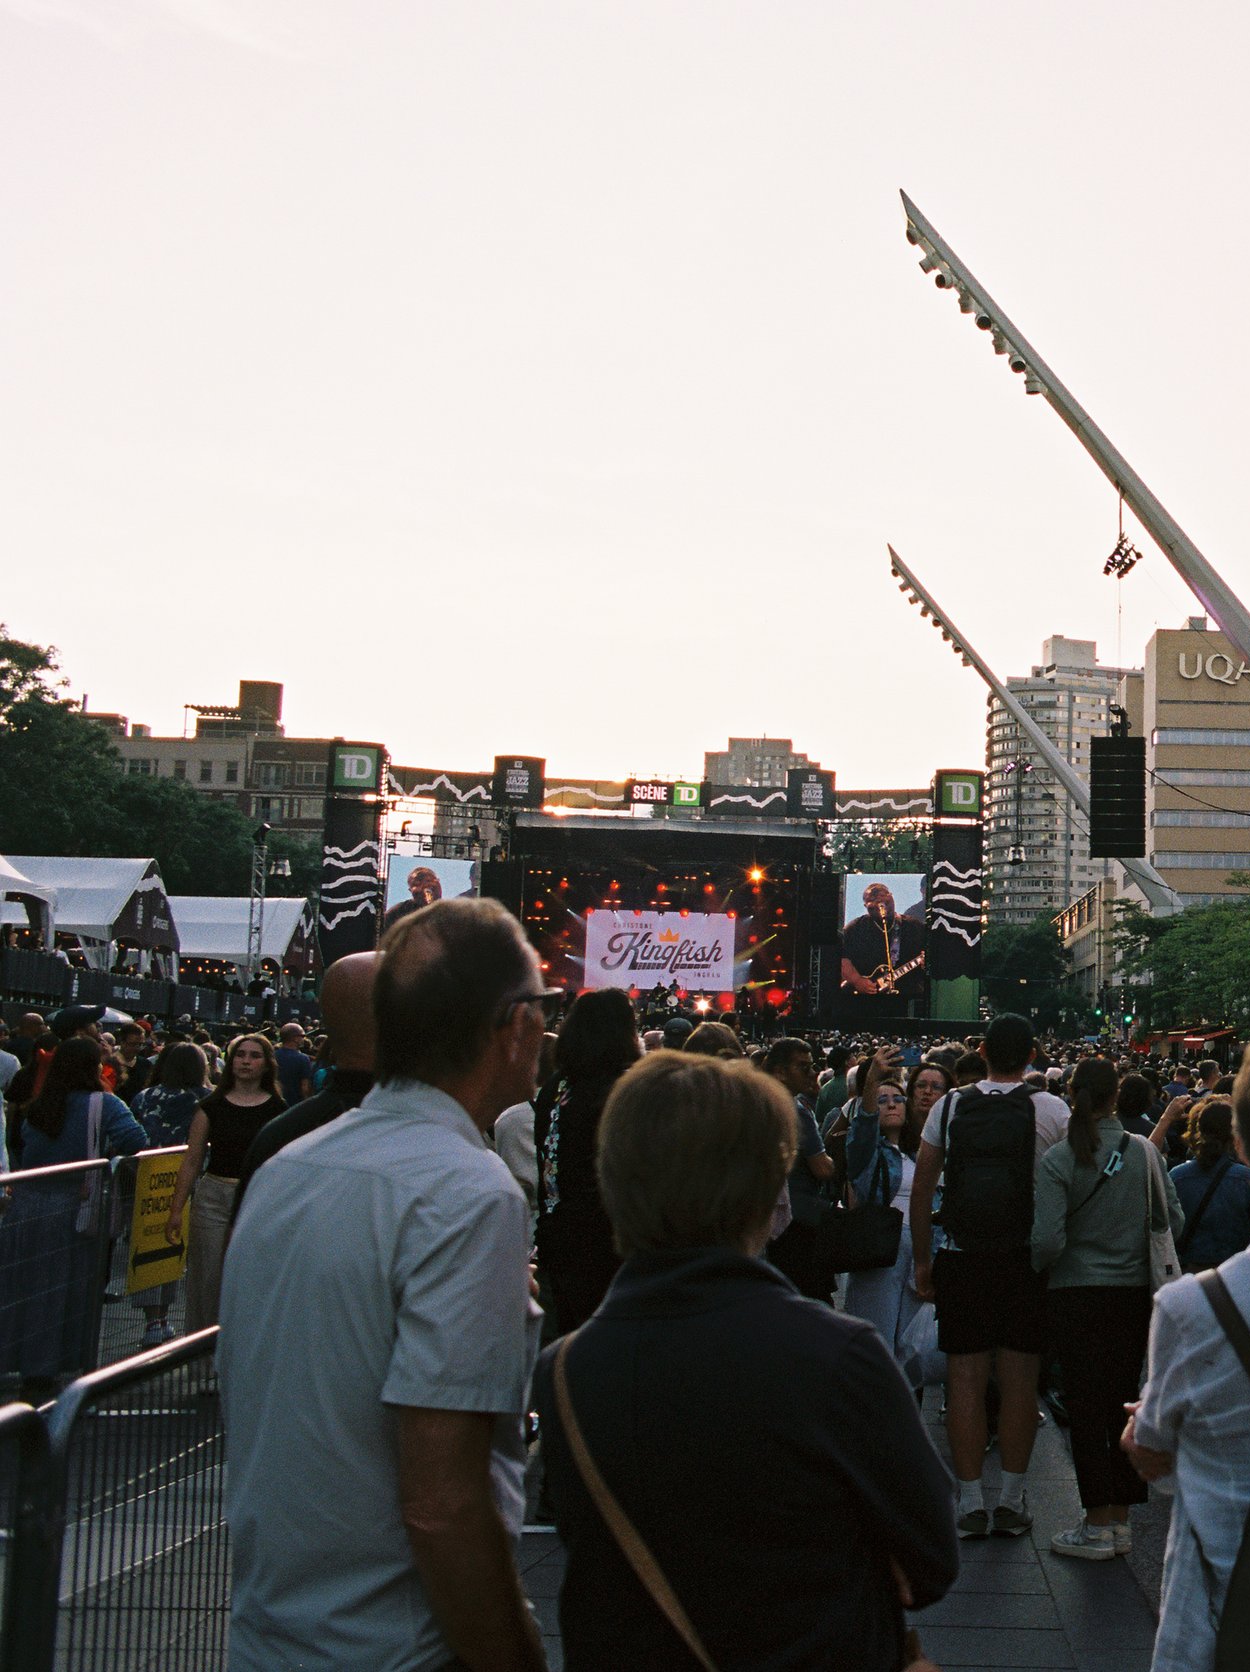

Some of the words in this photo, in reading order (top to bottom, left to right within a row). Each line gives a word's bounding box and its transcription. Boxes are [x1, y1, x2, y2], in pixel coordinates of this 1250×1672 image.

[339, 755, 372, 779] TD
[632, 784, 667, 800] SCÈNE
[677, 786, 698, 802] TD
[945, 781, 976, 804] TD
[601, 931, 723, 974] Kingfish
